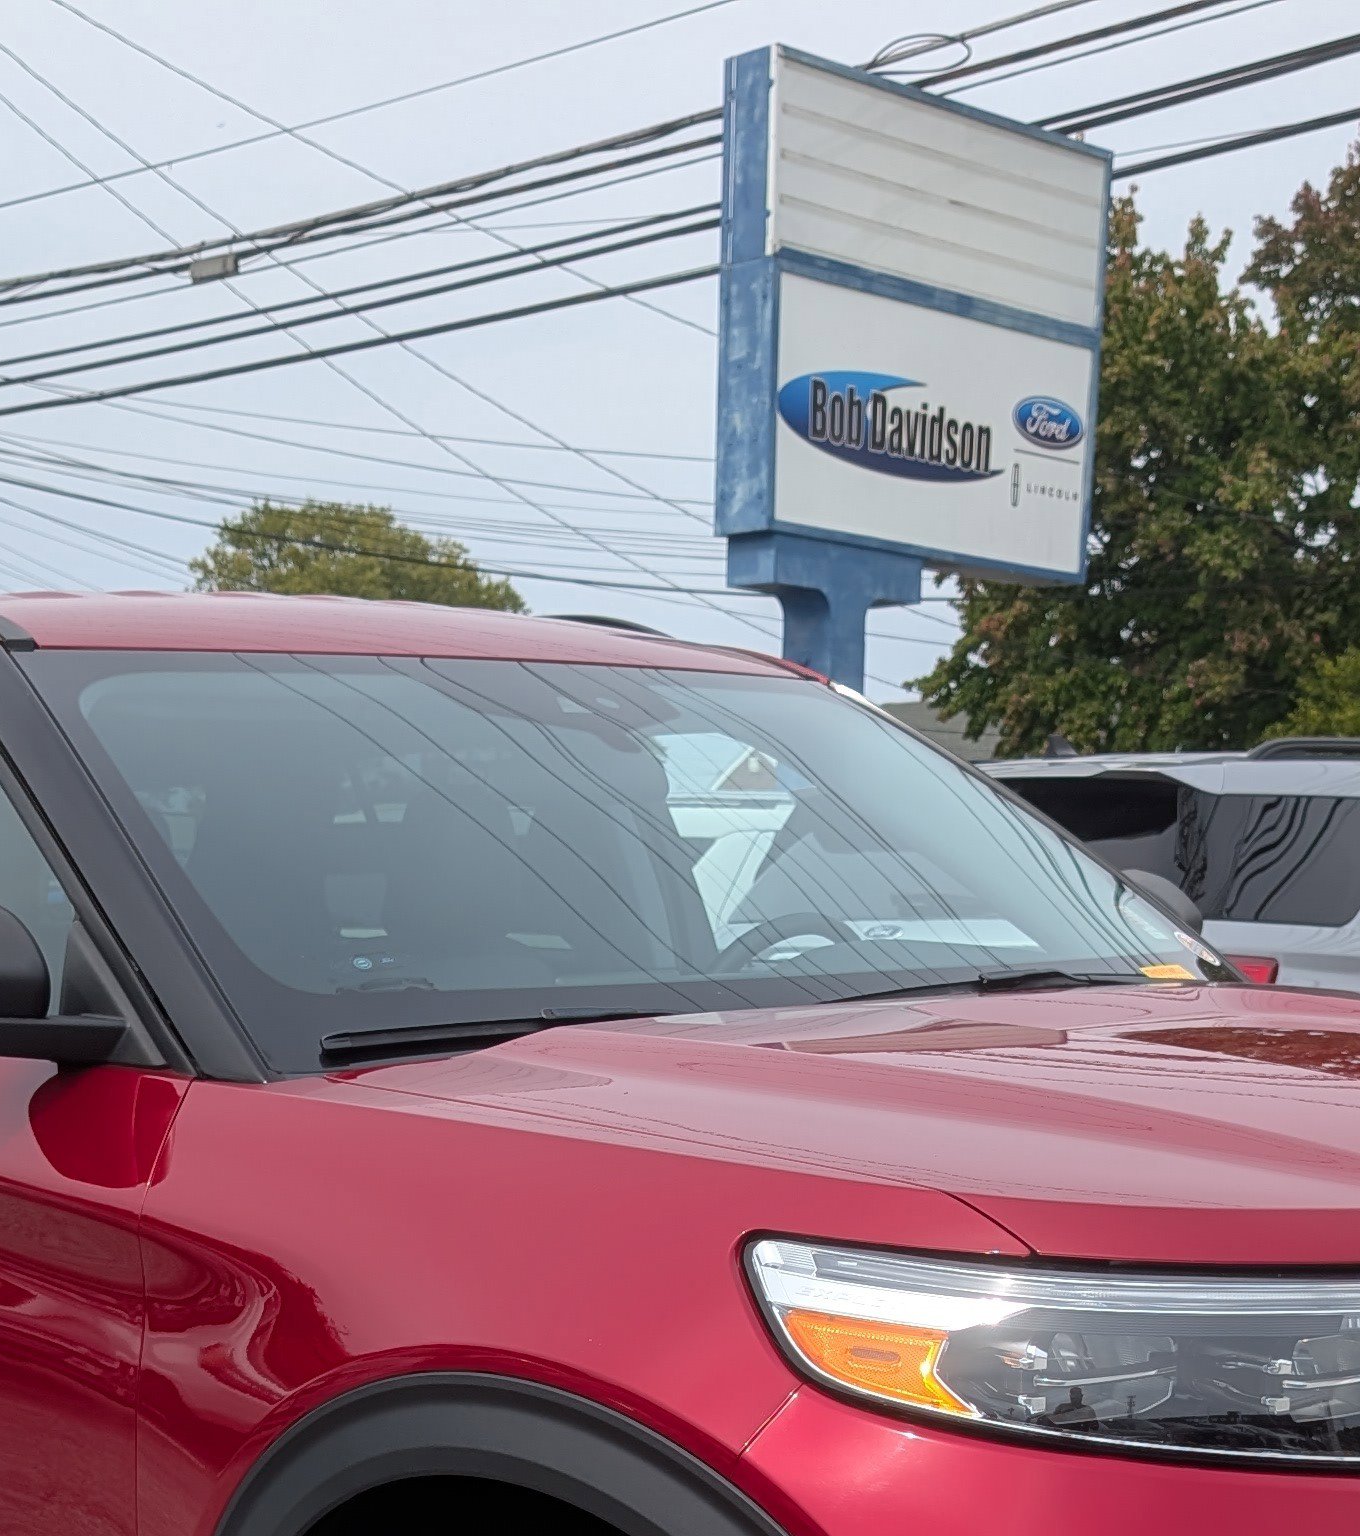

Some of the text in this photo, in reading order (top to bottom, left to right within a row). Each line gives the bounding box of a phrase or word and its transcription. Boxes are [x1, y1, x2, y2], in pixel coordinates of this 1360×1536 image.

[808, 376, 993, 474] Bob Davidson
[1026, 403, 1072, 441] Ford
